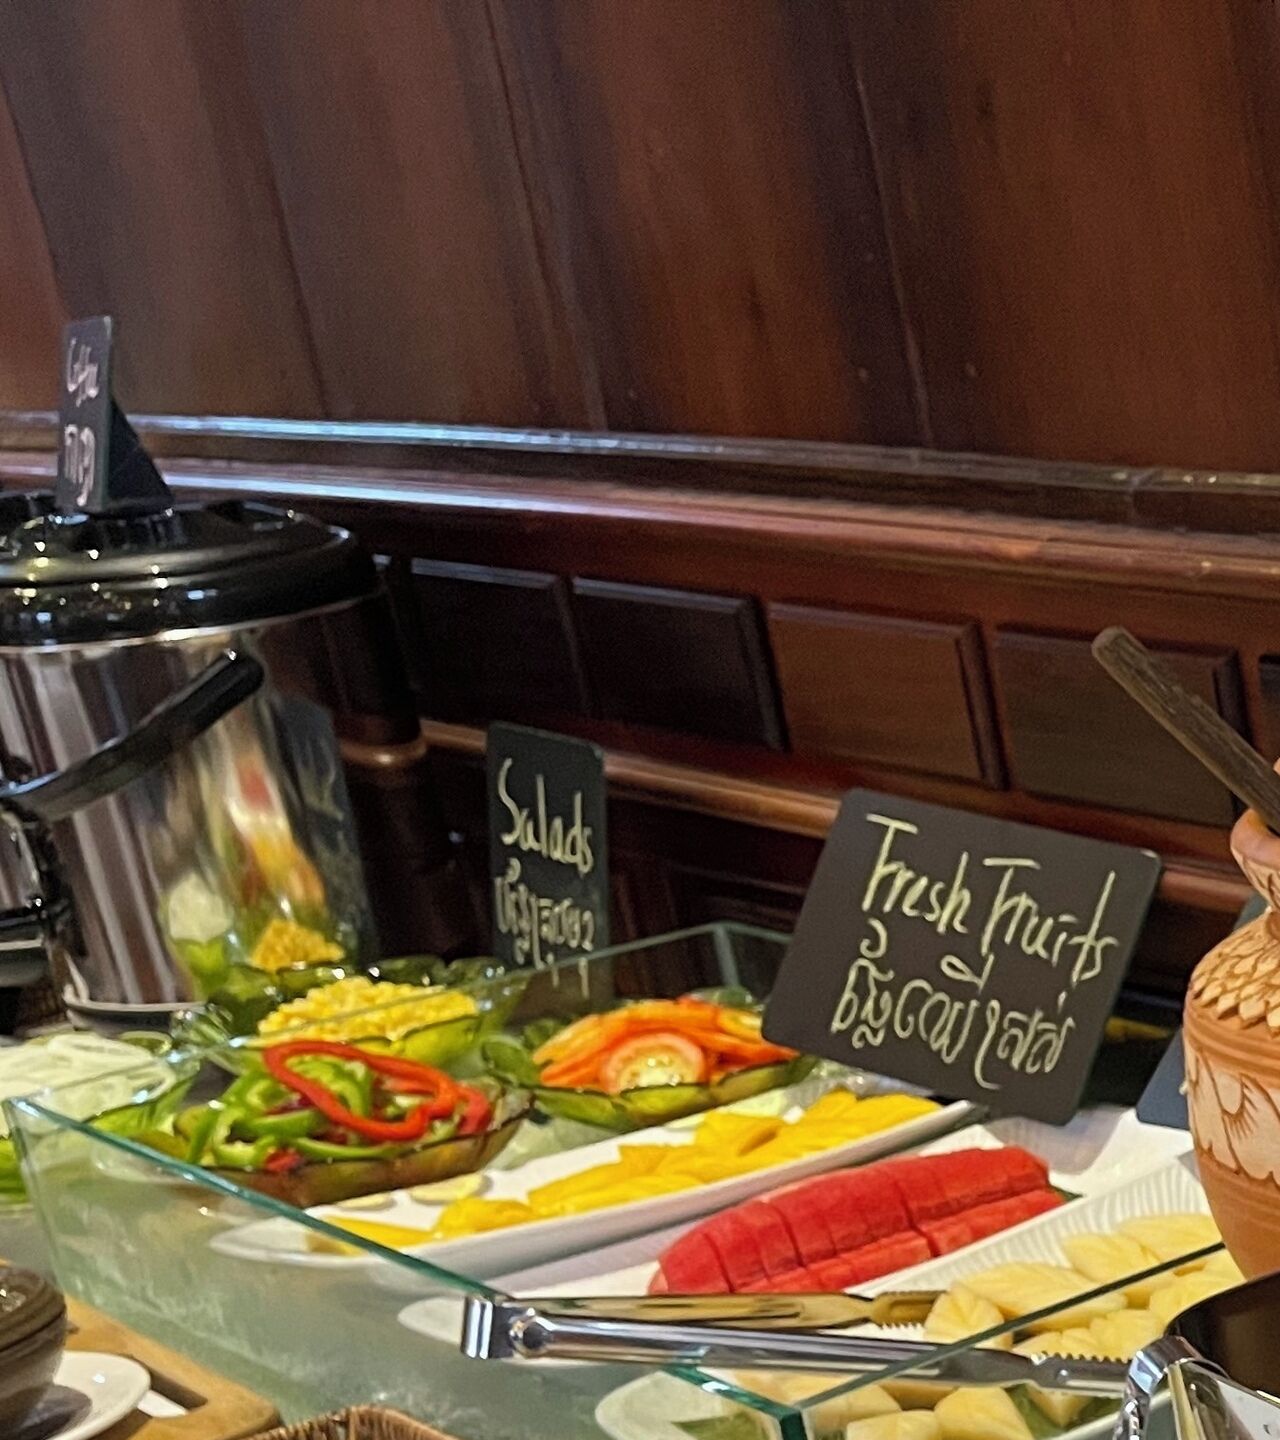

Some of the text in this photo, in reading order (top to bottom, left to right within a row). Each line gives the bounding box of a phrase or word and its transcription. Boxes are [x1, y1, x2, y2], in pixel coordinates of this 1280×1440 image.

[498, 757, 594, 877] Salads
[861, 813, 1119, 988] Fresh Fruits
